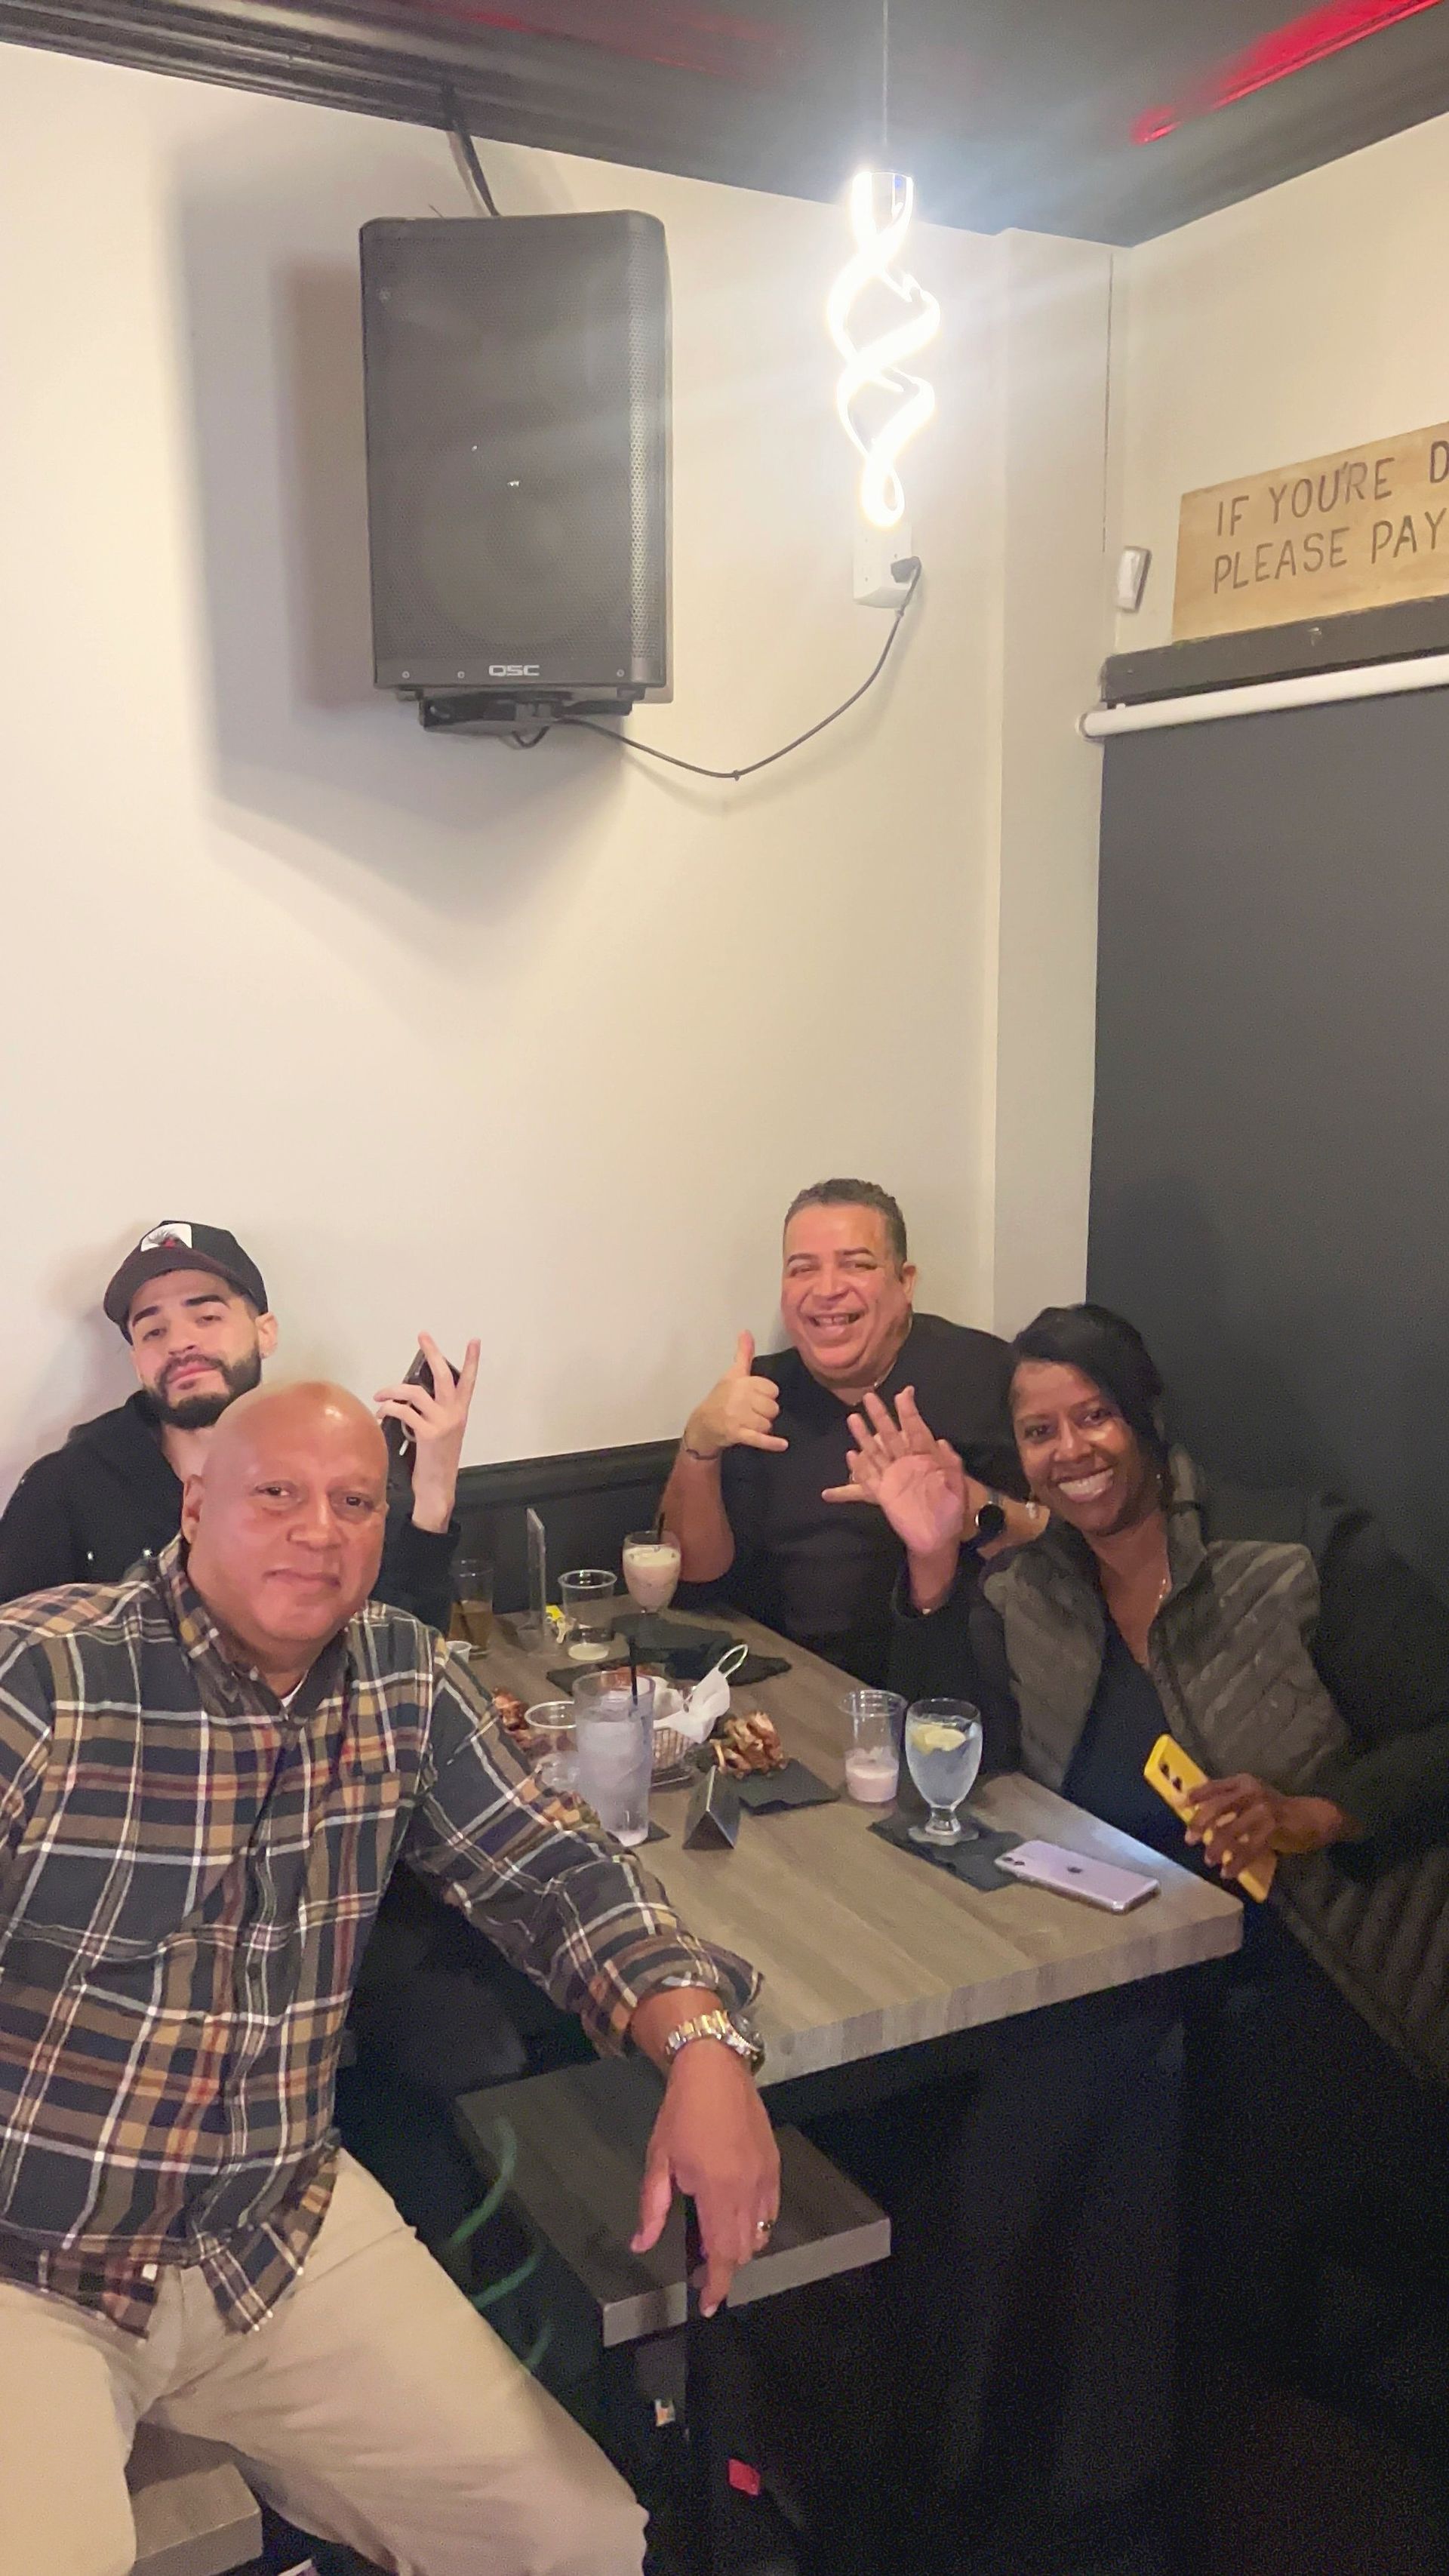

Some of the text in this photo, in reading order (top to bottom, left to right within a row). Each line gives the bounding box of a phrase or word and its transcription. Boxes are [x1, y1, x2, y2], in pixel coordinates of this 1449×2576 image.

[1217, 495, 1249, 537] IF
[1269, 457, 1395, 524] YOU'RE
[1214, 507, 1447, 594] PLEASE PAY
[488, 664, 540, 677] QSC
